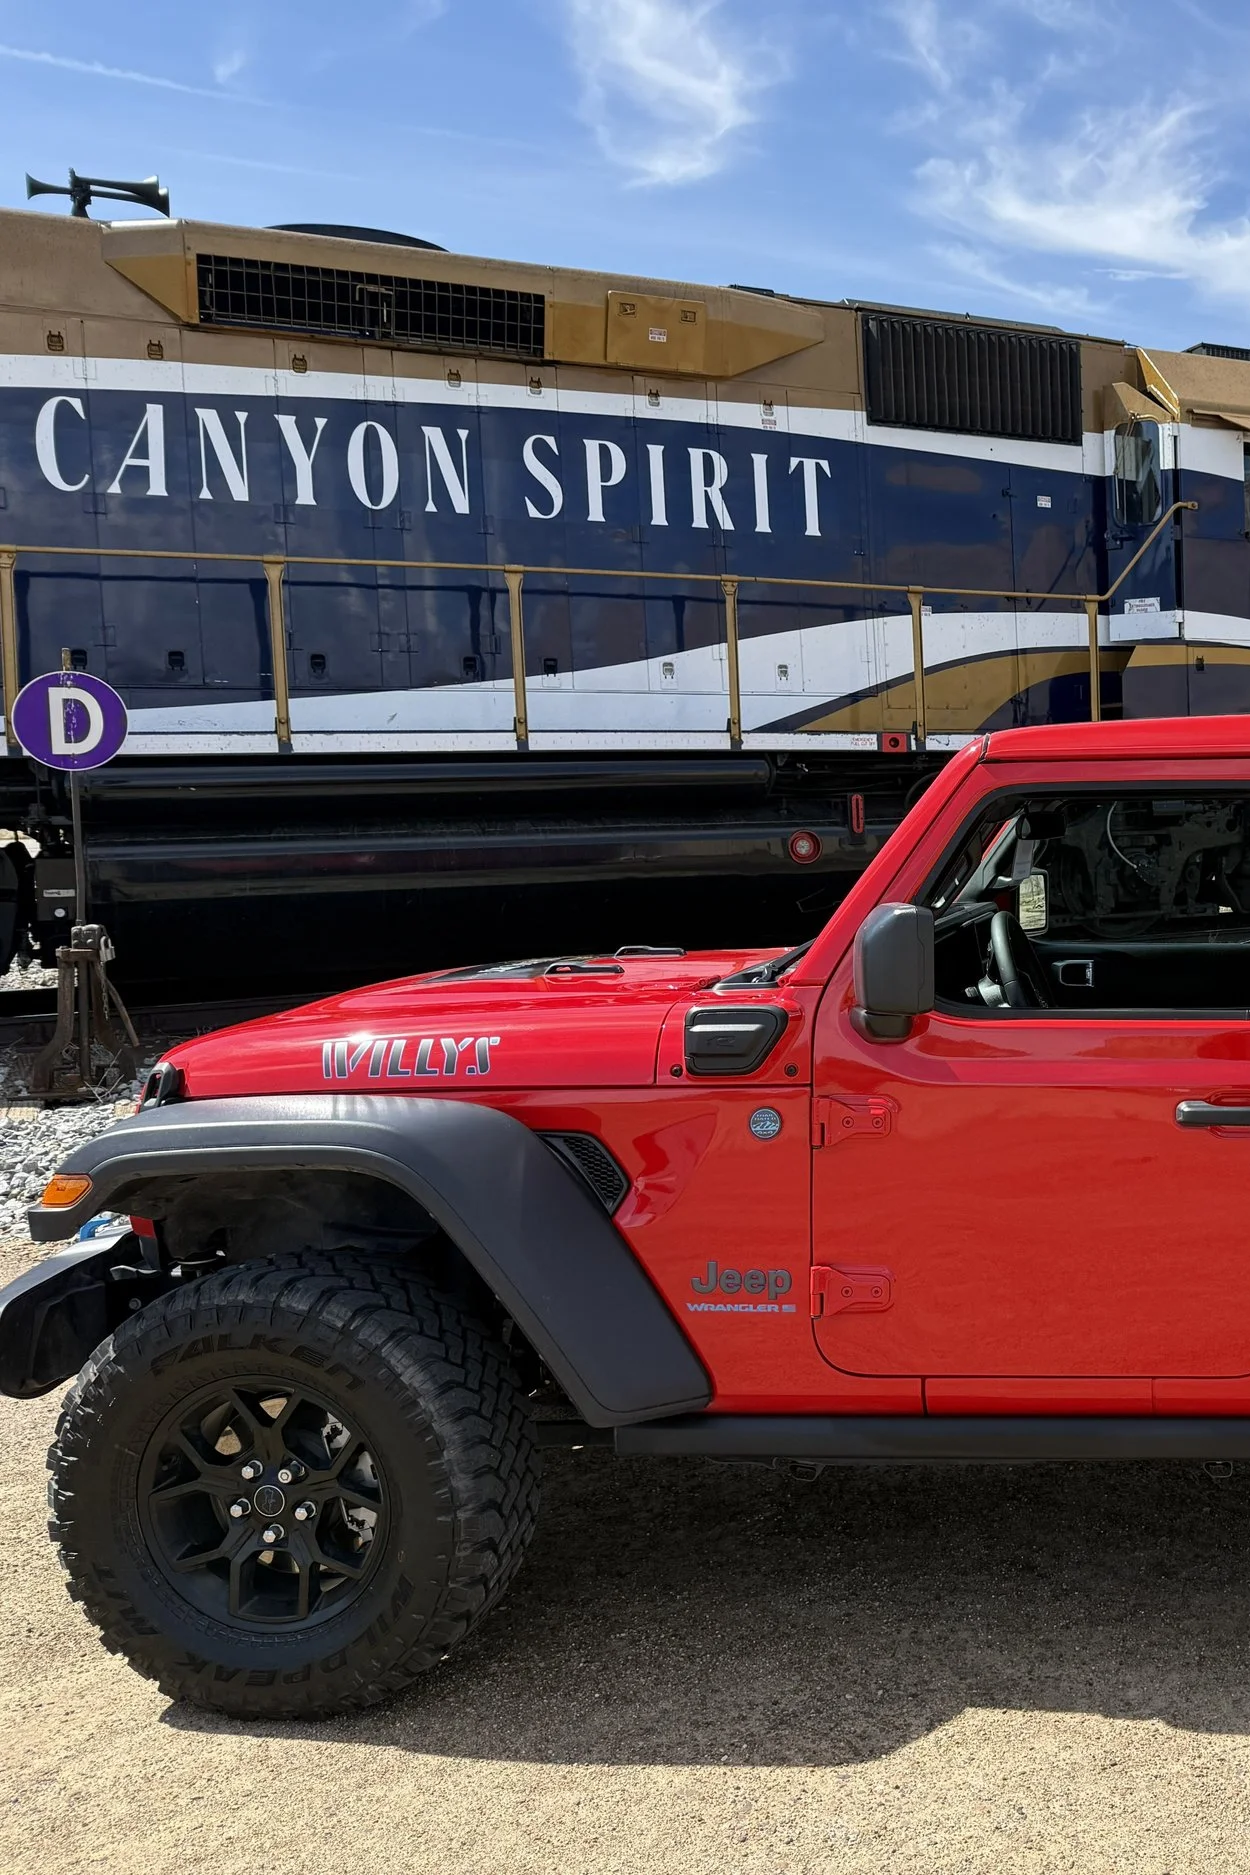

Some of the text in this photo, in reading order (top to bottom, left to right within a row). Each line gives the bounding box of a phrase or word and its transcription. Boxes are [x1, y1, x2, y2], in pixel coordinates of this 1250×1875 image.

[35, 396, 831, 536] CANYON SPIRIT
[48, 687, 104, 755] D
[322, 1036, 501, 1079] WILLYS
[690, 1261, 792, 1301] Jeep
[686, 1302, 780, 1313] WRANGLER
